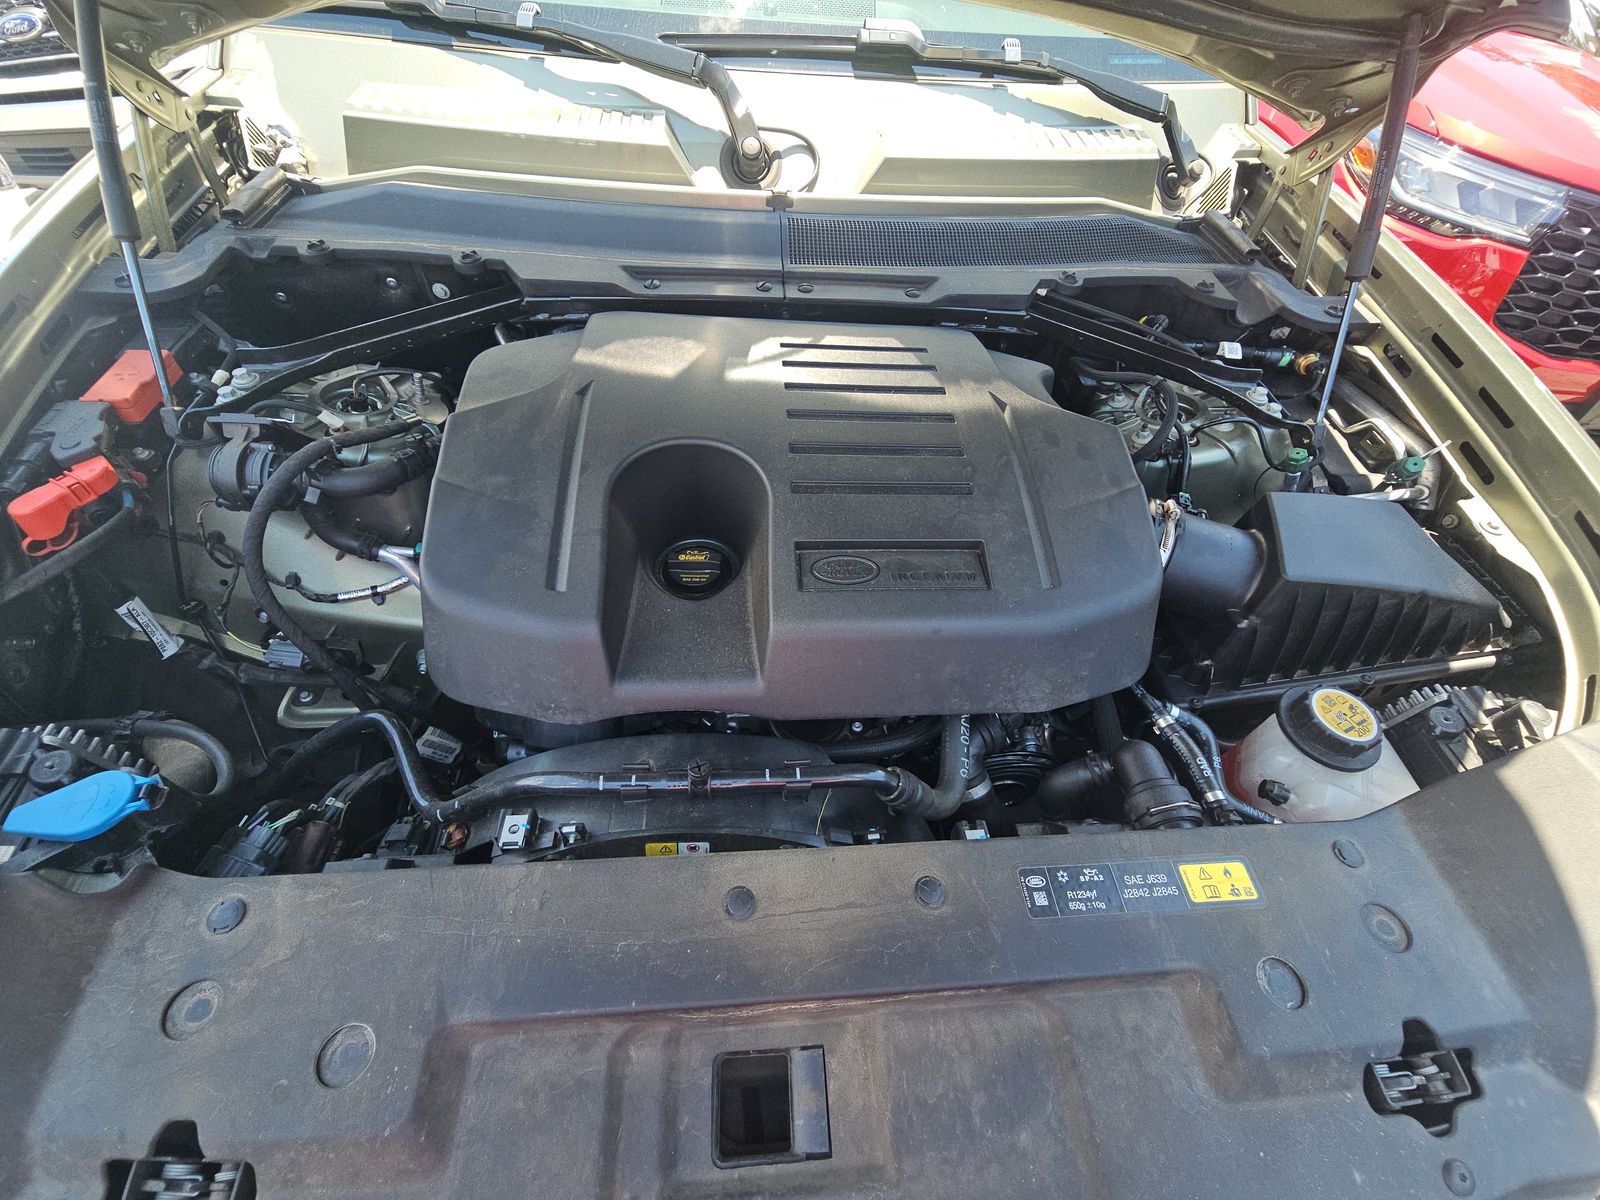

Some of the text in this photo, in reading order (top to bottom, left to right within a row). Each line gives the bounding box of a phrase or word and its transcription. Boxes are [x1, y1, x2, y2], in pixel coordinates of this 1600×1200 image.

[4, 19, 29, 35] Ford
[1354, 726, 1370, 737] 200
[1197, 757, 1214, 777] RAD
[1124, 874, 1168, 885] SAE J639
[1067, 890, 1098, 900] R1234yf
[1123, 886, 1179, 898] J2842 J2845
